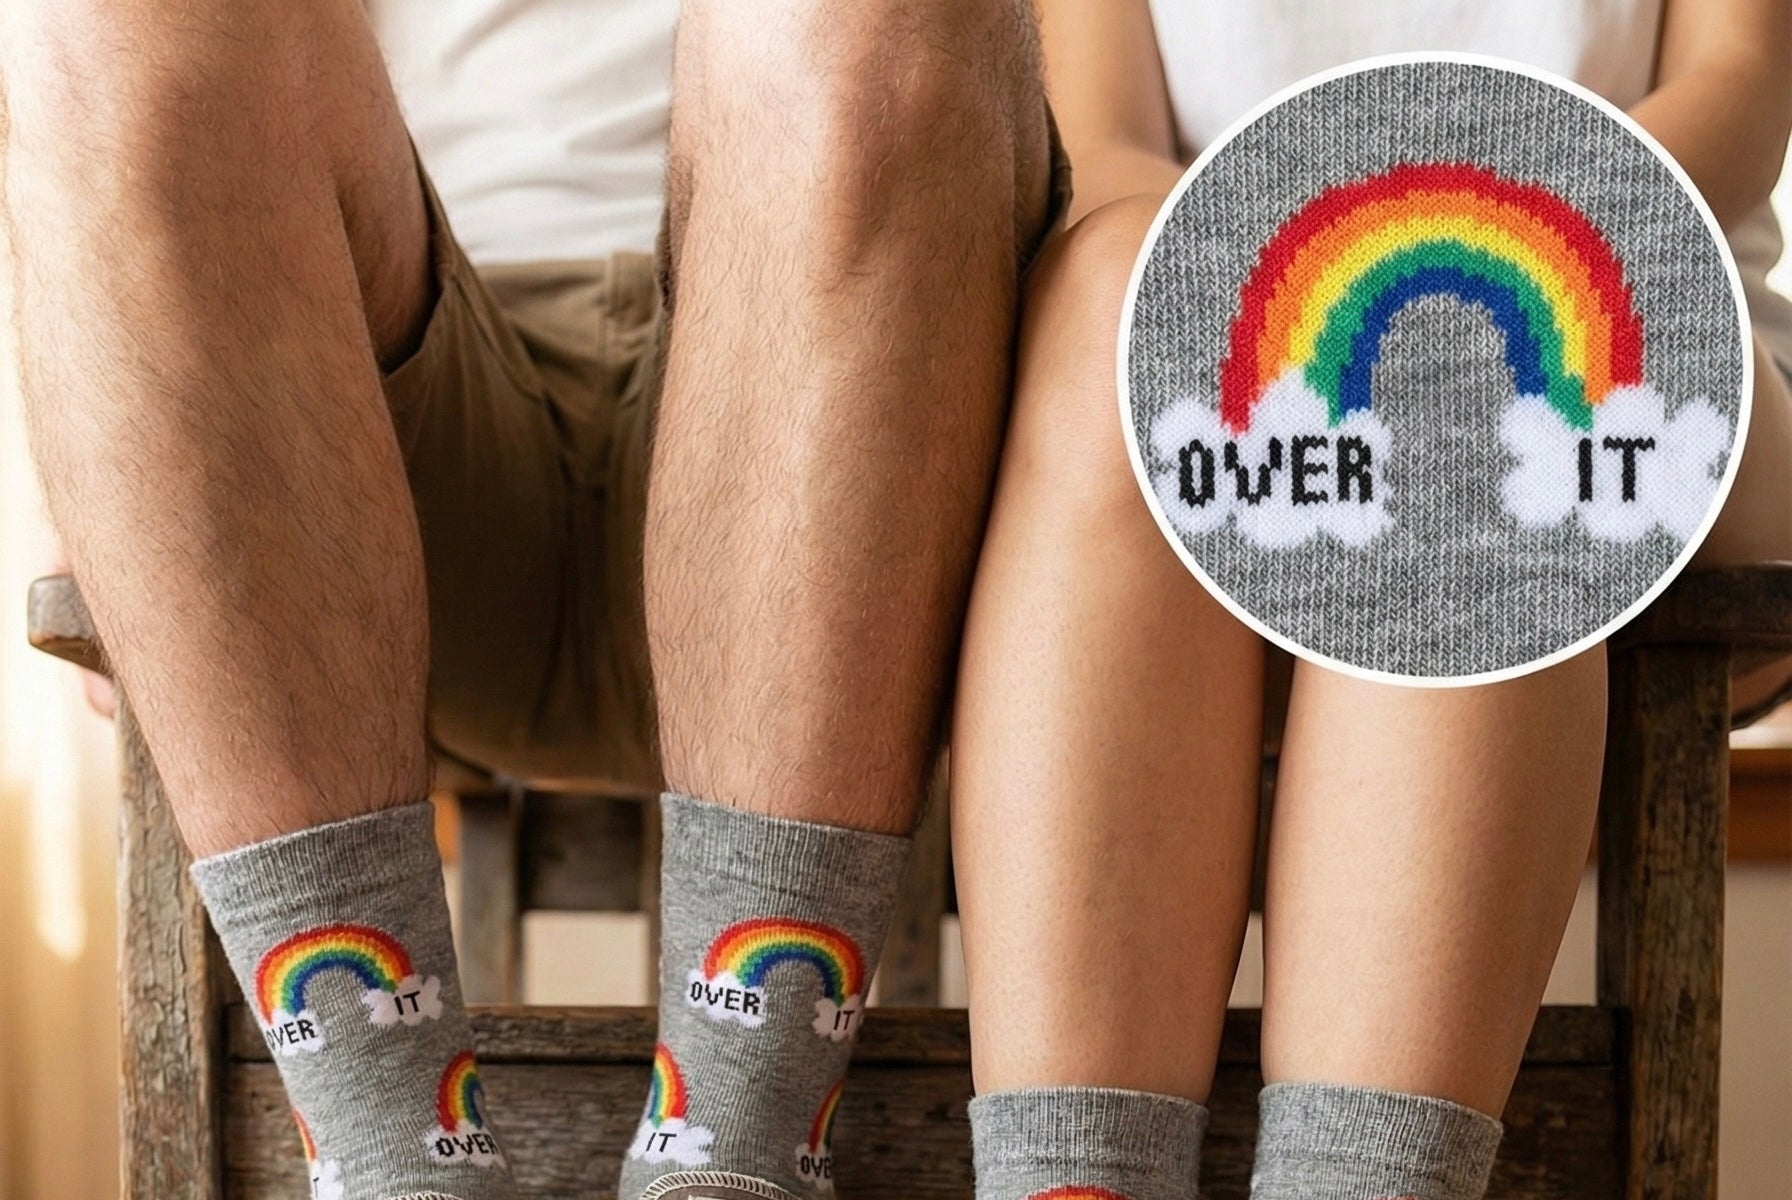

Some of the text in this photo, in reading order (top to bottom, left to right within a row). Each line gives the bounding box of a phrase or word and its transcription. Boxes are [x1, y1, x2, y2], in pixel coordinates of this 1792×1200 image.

[1178, 436, 1656, 507] OVER IT
[267, 990, 422, 1051] OVER IT
[691, 981, 856, 1031] OVER IT
[646, 1132, 677, 1153] IT
[800, 1155, 832, 1179] OVE
